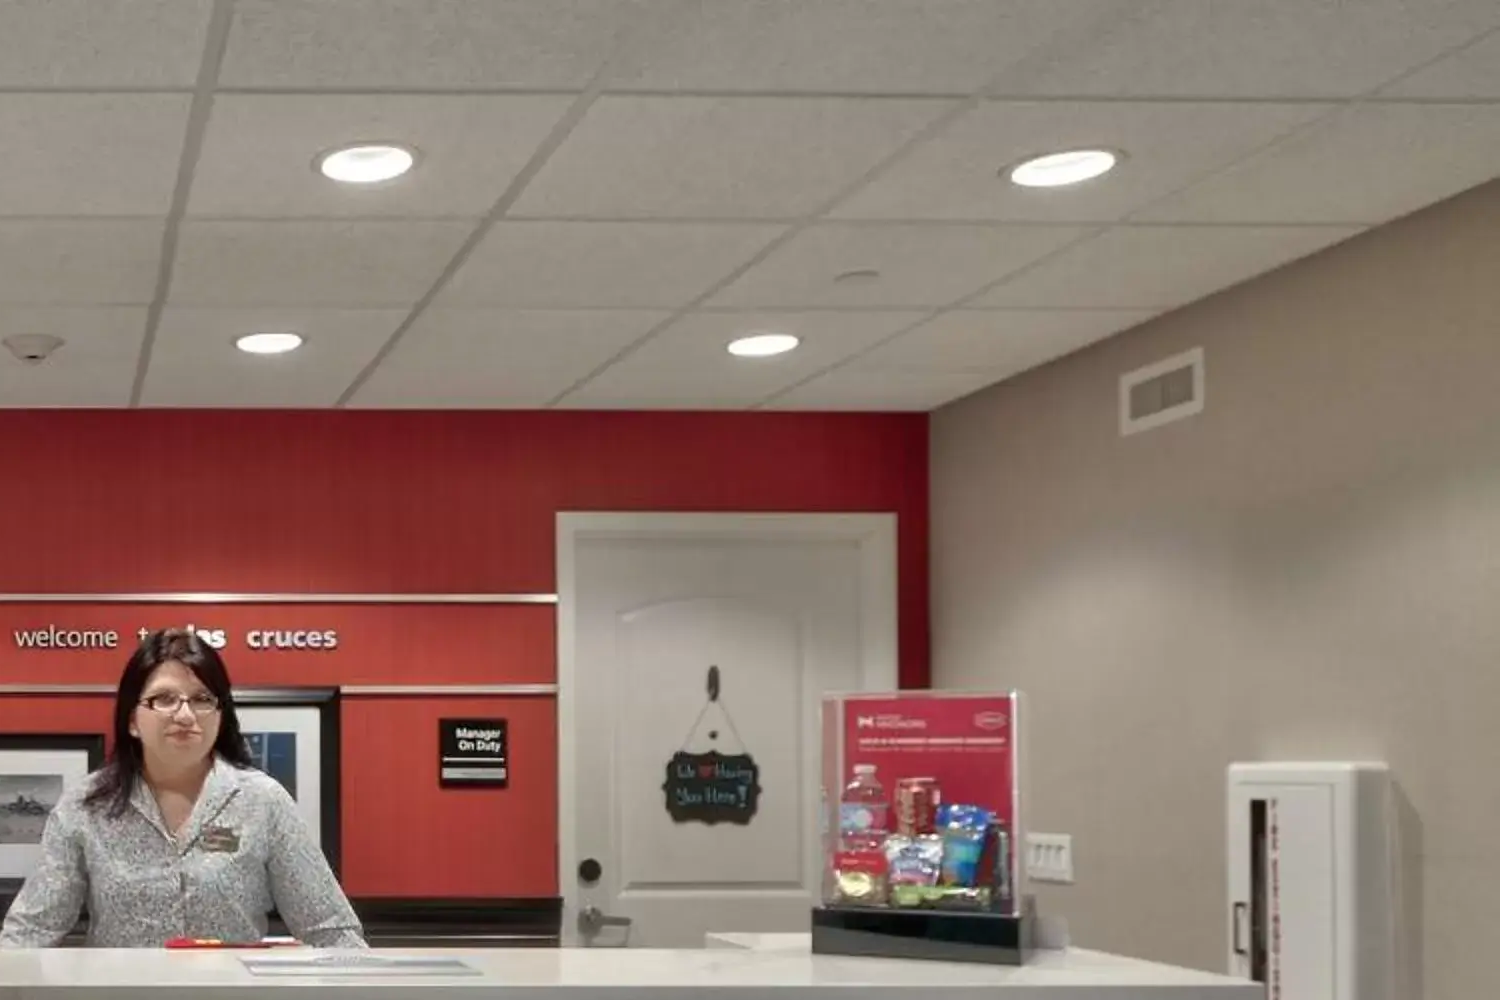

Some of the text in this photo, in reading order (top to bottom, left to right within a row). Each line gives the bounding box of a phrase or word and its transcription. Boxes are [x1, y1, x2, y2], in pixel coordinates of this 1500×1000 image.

[14, 624, 118, 648] welcome
[246, 628, 338, 649] cruces
[455, 727, 501, 741] Manager
[458, 740, 501, 752] On Duty
